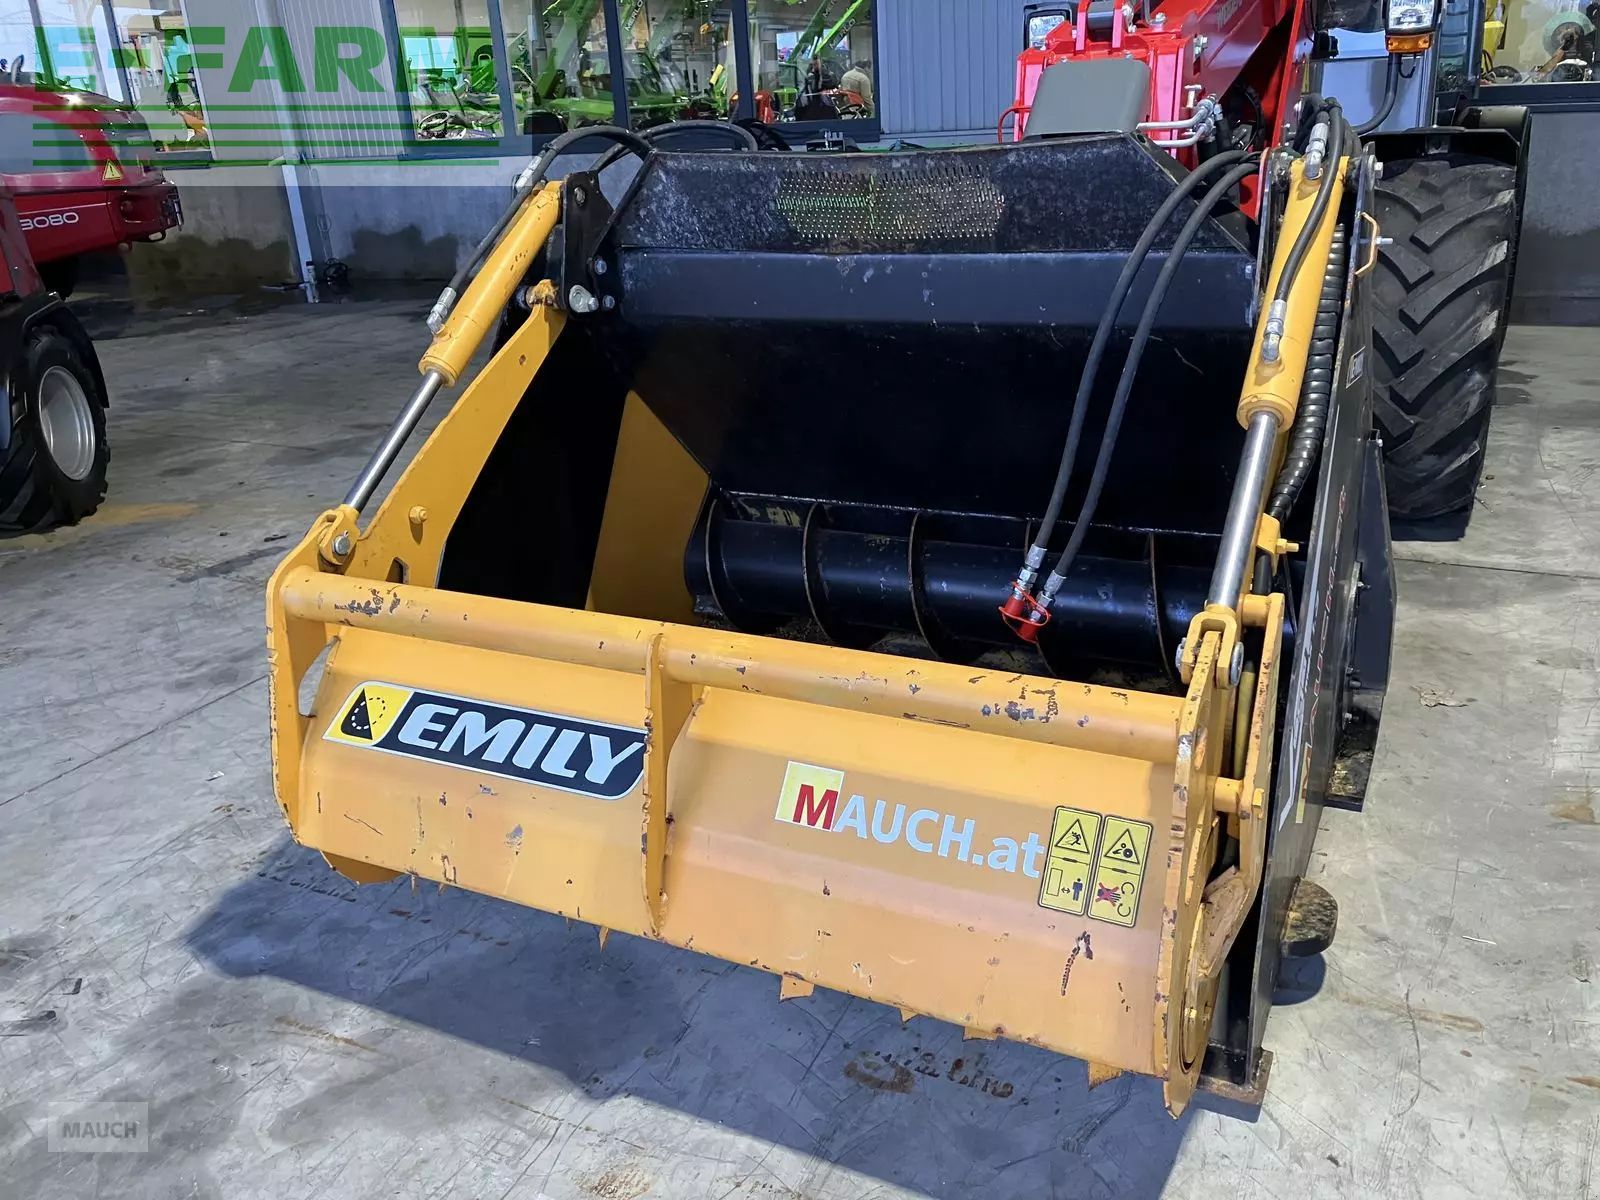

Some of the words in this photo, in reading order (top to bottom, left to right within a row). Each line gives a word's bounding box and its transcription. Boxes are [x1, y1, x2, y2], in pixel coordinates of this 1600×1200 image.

[624, 0, 643, 31] MERLO
[19, 211, 79, 231] 3080
[397, 703, 645, 784] EMILY
[792, 783, 1045, 878] MAUCH.at
